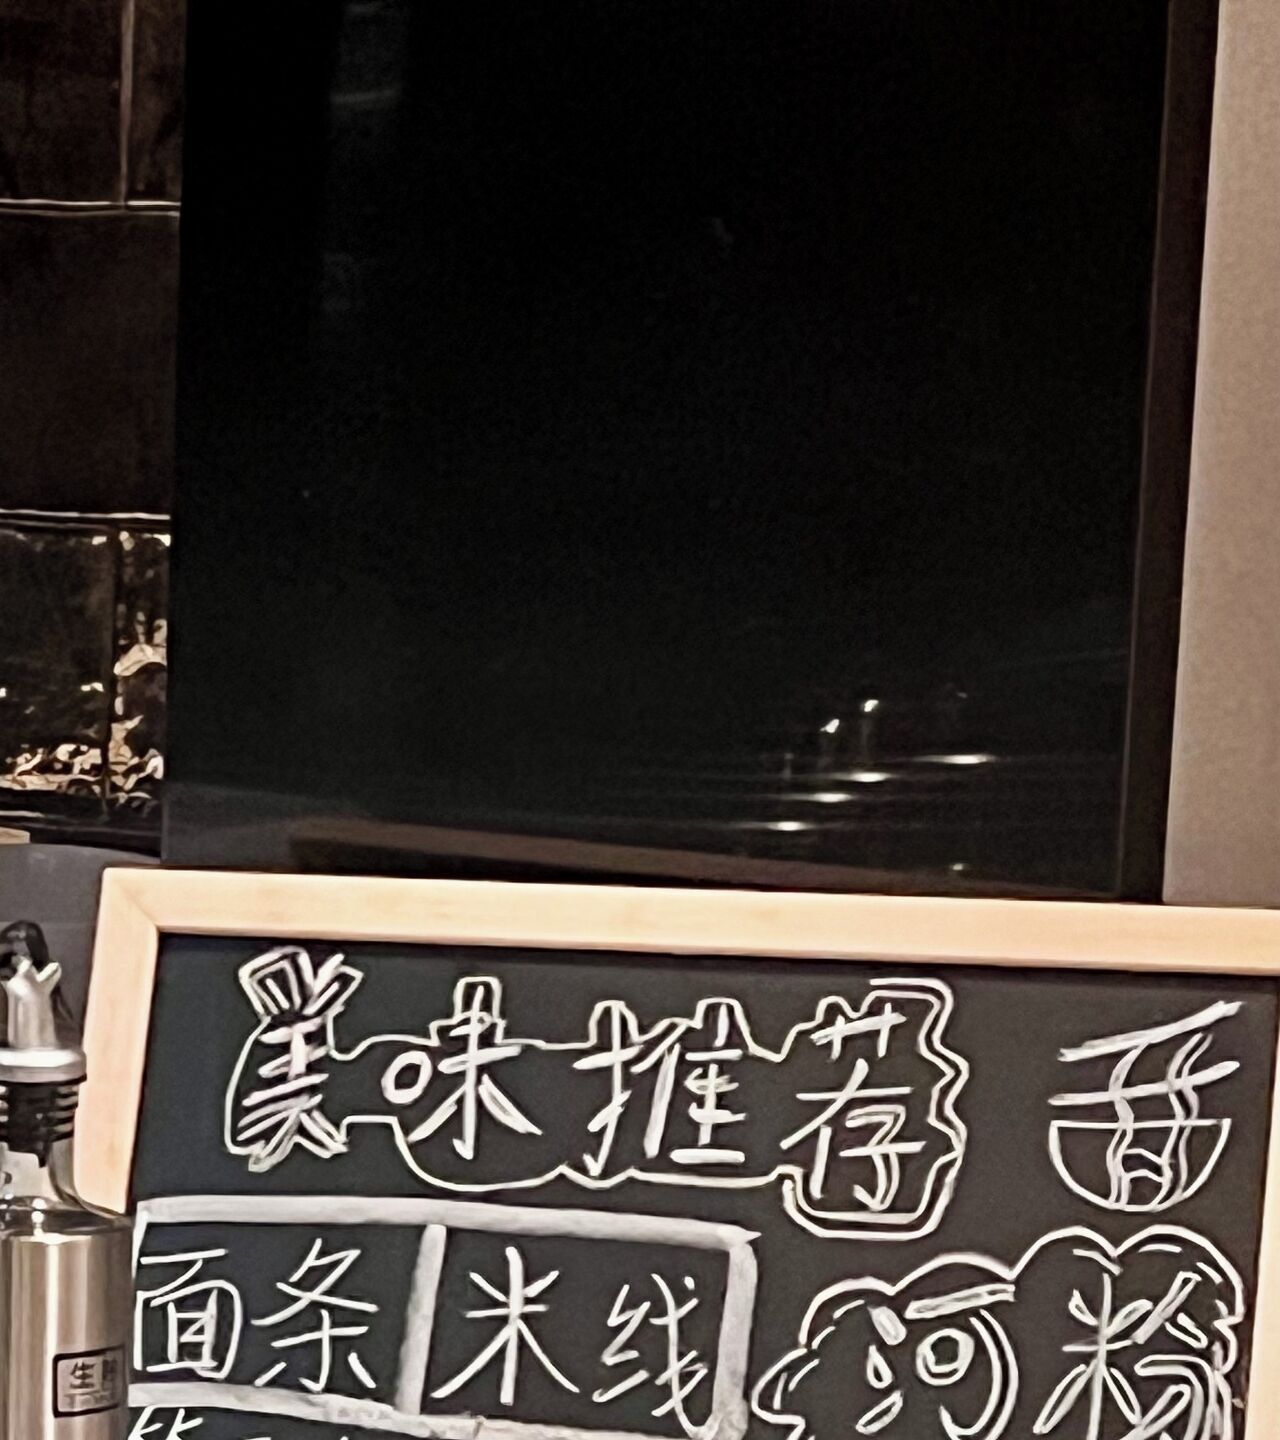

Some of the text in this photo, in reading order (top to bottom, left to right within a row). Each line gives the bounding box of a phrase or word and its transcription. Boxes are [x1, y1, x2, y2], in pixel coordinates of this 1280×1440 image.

[238, 946, 928, 1212] 美味推荐
[132, 1238, 380, 1392] 面条
